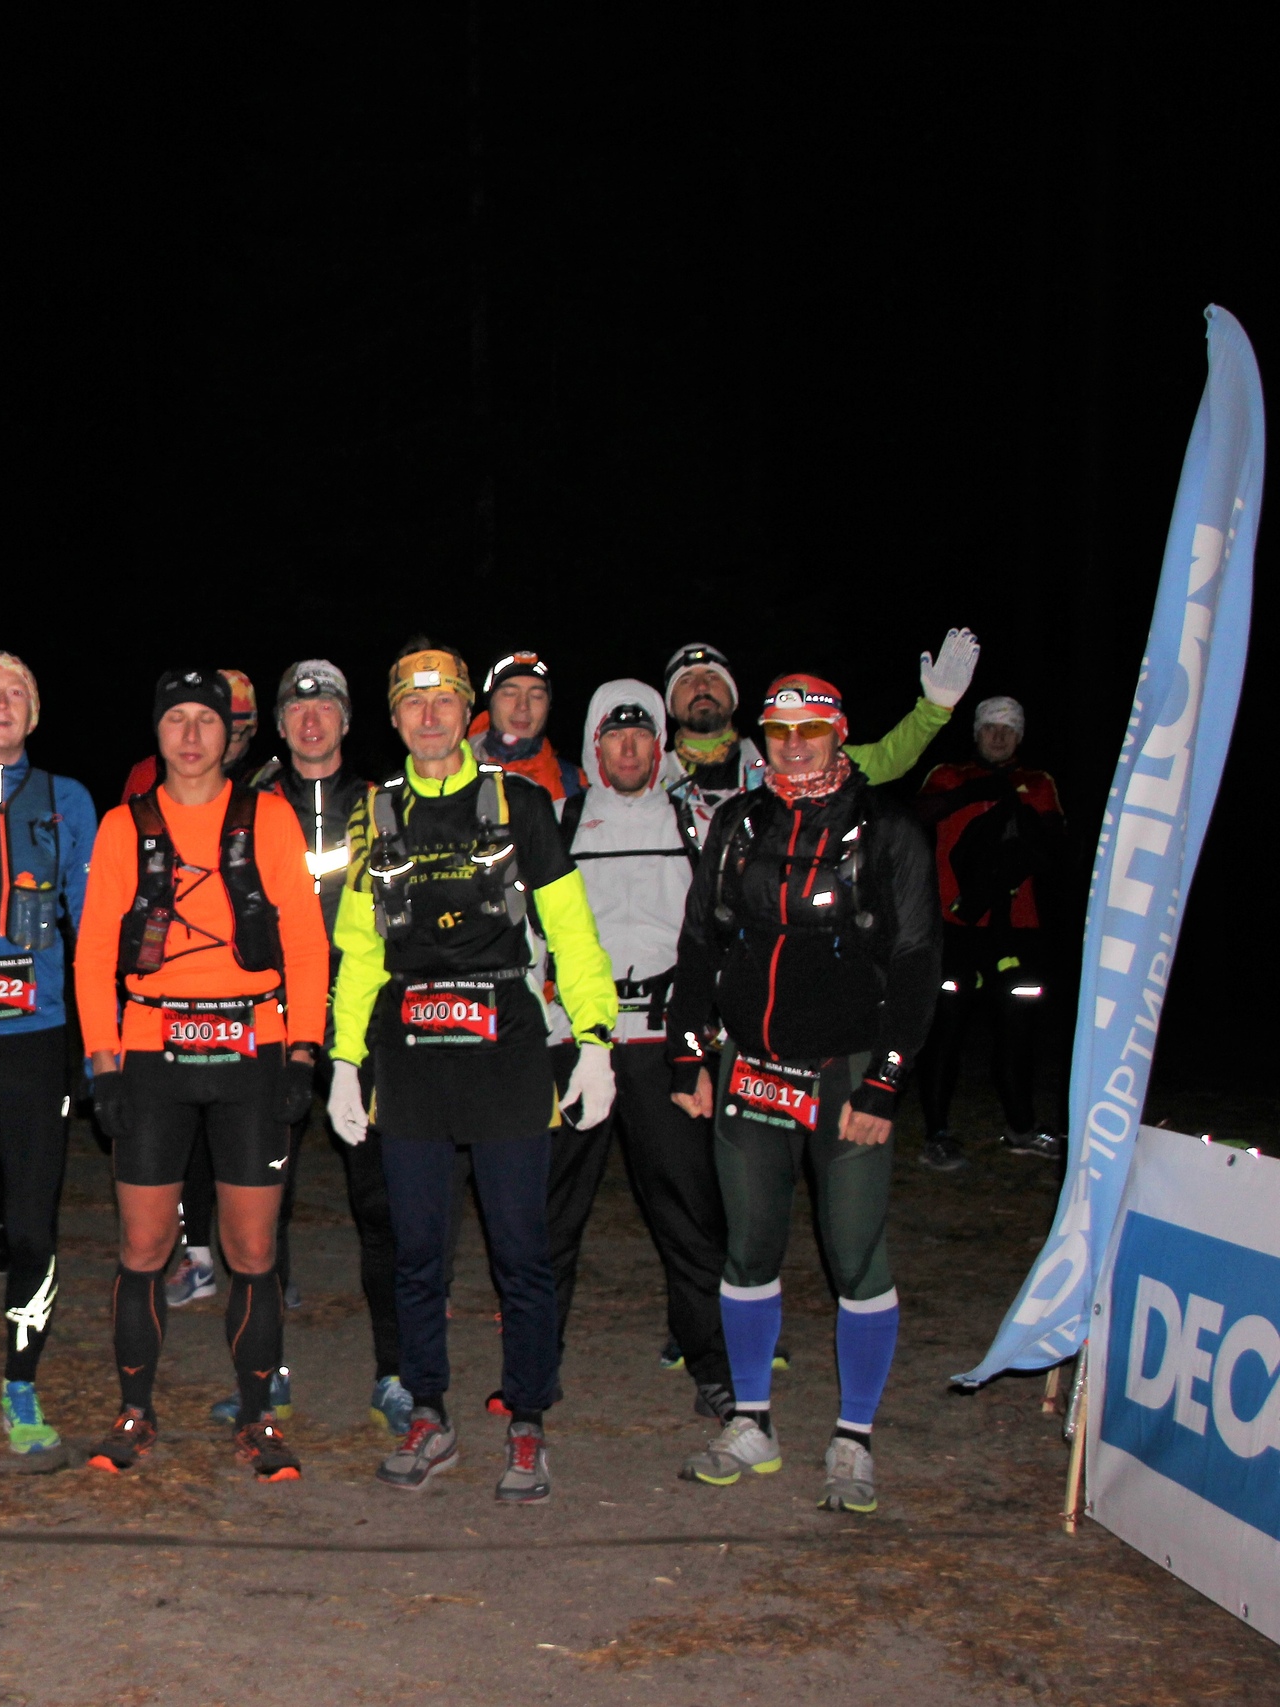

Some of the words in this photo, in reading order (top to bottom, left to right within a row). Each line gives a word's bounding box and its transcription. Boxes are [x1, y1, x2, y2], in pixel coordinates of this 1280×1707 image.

[411, 1001, 483, 1022] 10001
[170, 1021, 244, 1042] 10019
[737, 1076, 806, 1108] 10017
